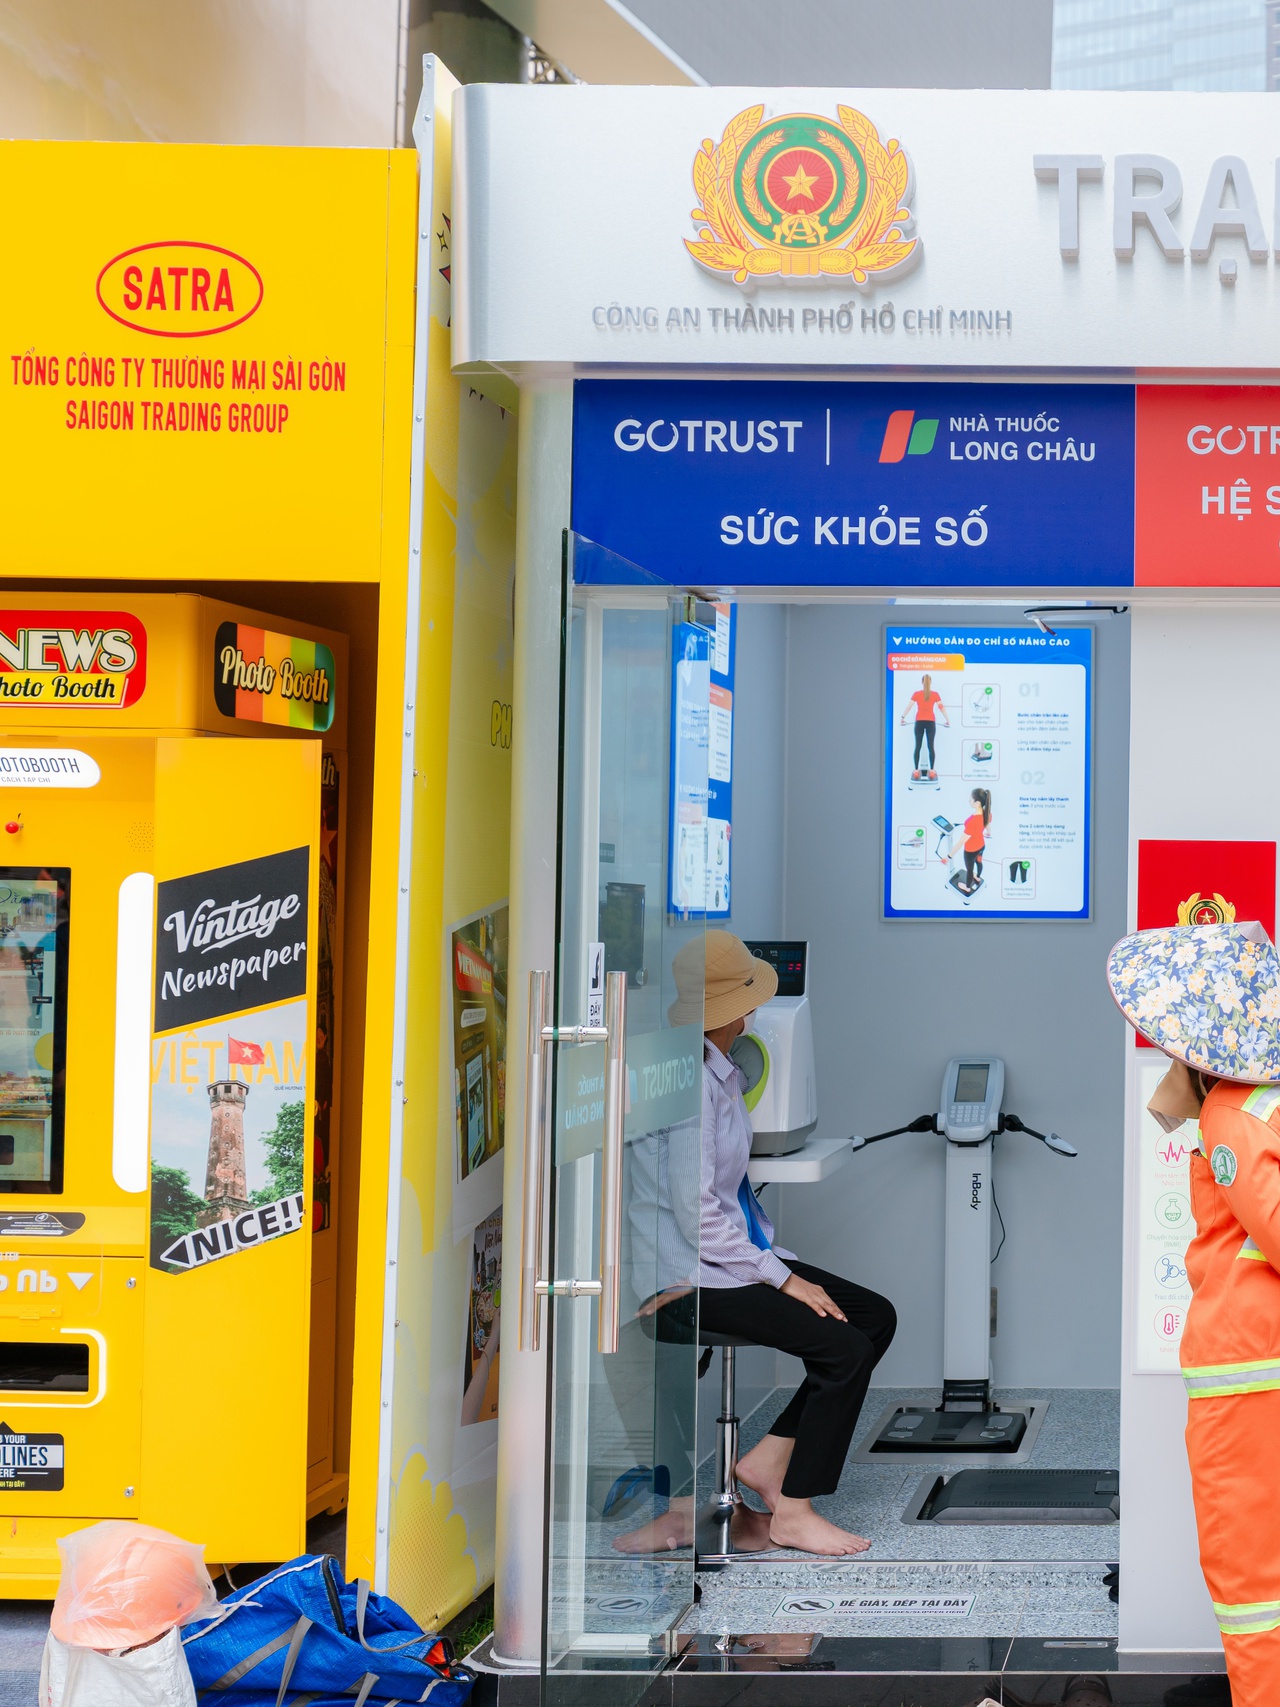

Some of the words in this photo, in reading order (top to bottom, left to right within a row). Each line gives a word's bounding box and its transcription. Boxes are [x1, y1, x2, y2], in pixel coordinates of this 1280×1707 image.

[123, 265, 234, 312] SATRA
[592, 302, 658, 328] CÔNG
[666, 307, 700, 329] AN
[709, 304, 795, 330] THÀNH
[802, 301, 855, 331] PHỐ
[861, 301, 896, 331] HỒ
[903, 305, 942, 330] CHÍ
[950, 309, 1012, 332] MINH
[11, 346, 59, 385] TỔNG
[65, 352, 115, 388] CÔNG
[122, 358, 145, 388] TY
[152, 355, 224, 390] THƯƠNG
[231, 360, 266, 394] MẠI
[272, 356, 302, 391] SÀI
[309, 356, 346, 392] GÒN
[65, 400, 134, 430] SAIGON
[141, 402, 221, 432] TRADING
[228, 403, 289, 433] GROUP
[949, 413, 989, 432] NHÀ
[995, 411, 1060, 433] THUỐC
[613, 418, 803, 453] GOTRUST
[949, 441, 1019, 462] LONG
[1026, 437, 1097, 462] CHÂU
[1201, 477, 1252, 521] HỆ
[720, 508, 799, 546] SỨC
[814, 504, 922, 546] KHỎE
[934, 504, 989, 547] SỐ
[0, 628, 138, 673] NEWS
[905, 636, 942, 646] HƯỚNG
[1049, 638, 1070, 647] CAO
[0, 676, 44, 698] hoto
[51, 675, 116, 699] Booth
[219, 644, 276, 694] Photo
[278, 657, 330, 705] Booth
[1018, 682, 1041, 697] 01
[0, 756, 80, 774] OTOBOOTH
[1020, 770, 1045, 785] 02
[163, 893, 301, 955] Vintage
[161, 940, 307, 1001] Newspaper
[152, 1029, 224, 1094] VIỆT
[969, 1172, 982, 1211] InBody
[193, 1194, 307, 1262] NICE!!
[4, 1435, 26, 1444] YOUR
[0, 1446, 48, 1467] LINES
[0, 1468, 15, 1478] ERE
[840, 1597, 858, 1607] ĐỂ
[921, 1599, 941, 1609] TẠI
